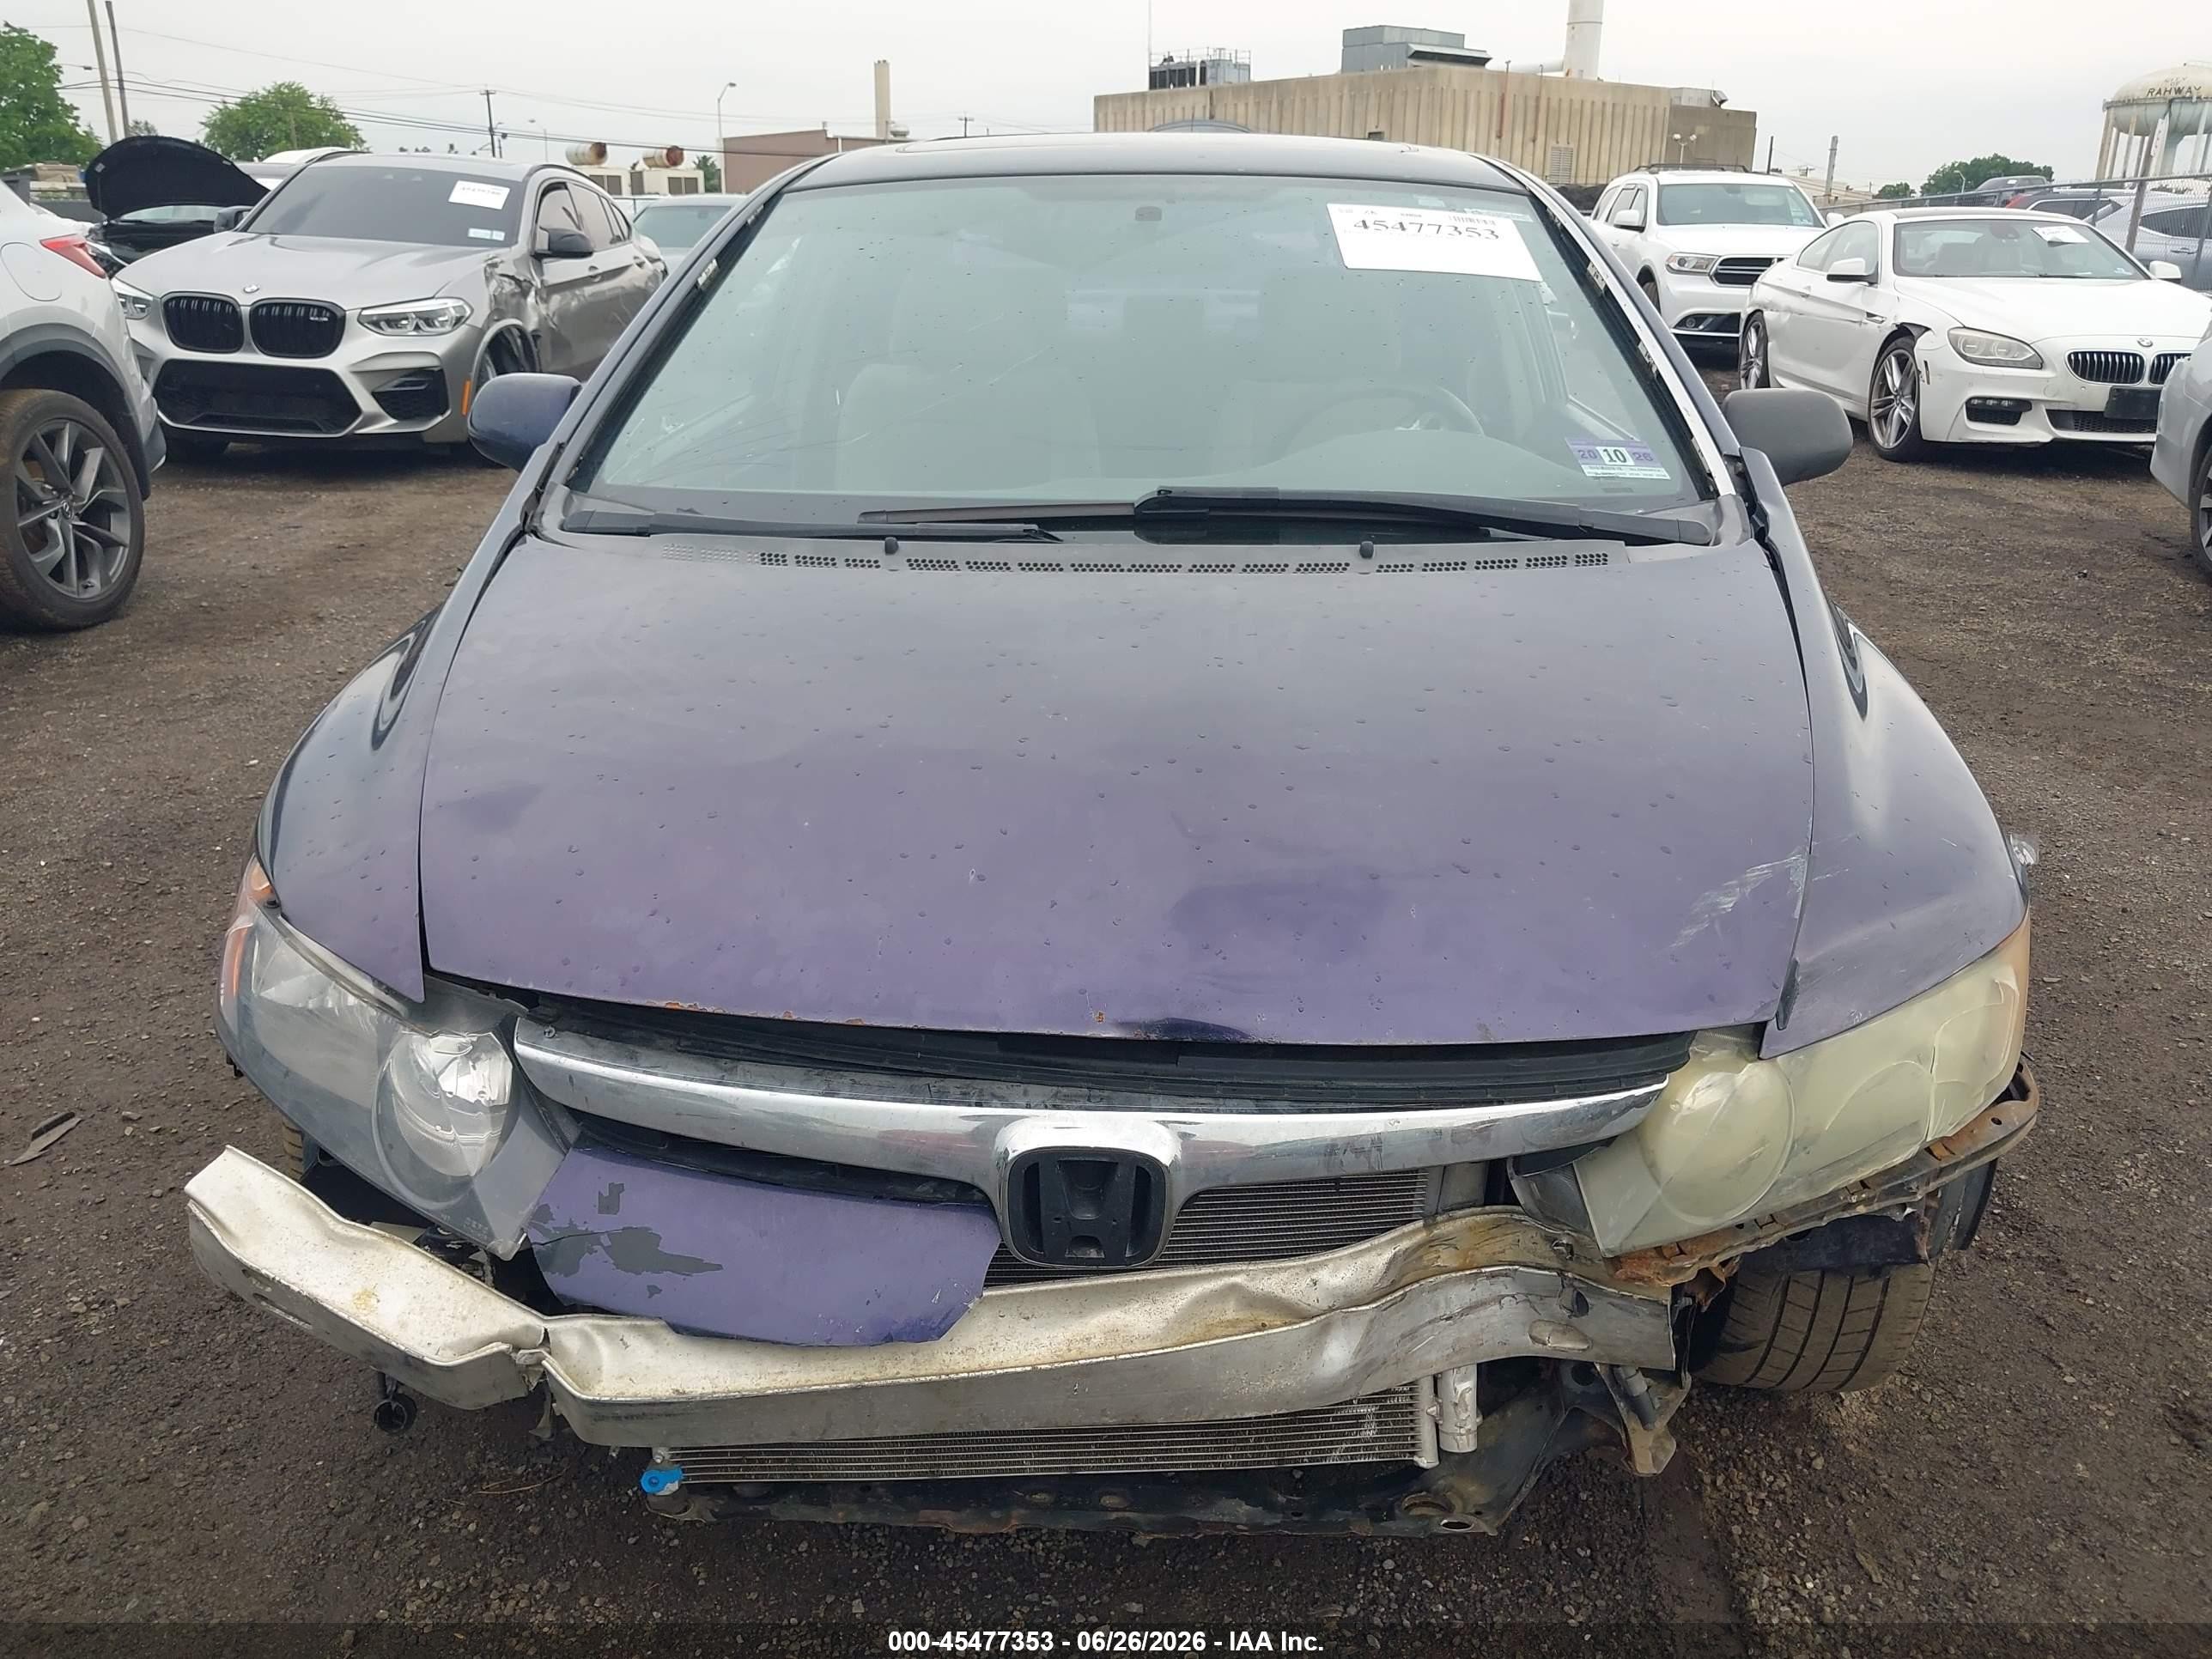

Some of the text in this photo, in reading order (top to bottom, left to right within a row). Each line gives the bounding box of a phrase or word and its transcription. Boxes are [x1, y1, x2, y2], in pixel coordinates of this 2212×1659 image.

[2146, 86, 2202, 97] RAHWAY
[1353, 218, 1500, 240] 45477353
[1602, 448, 1627, 464] 10
